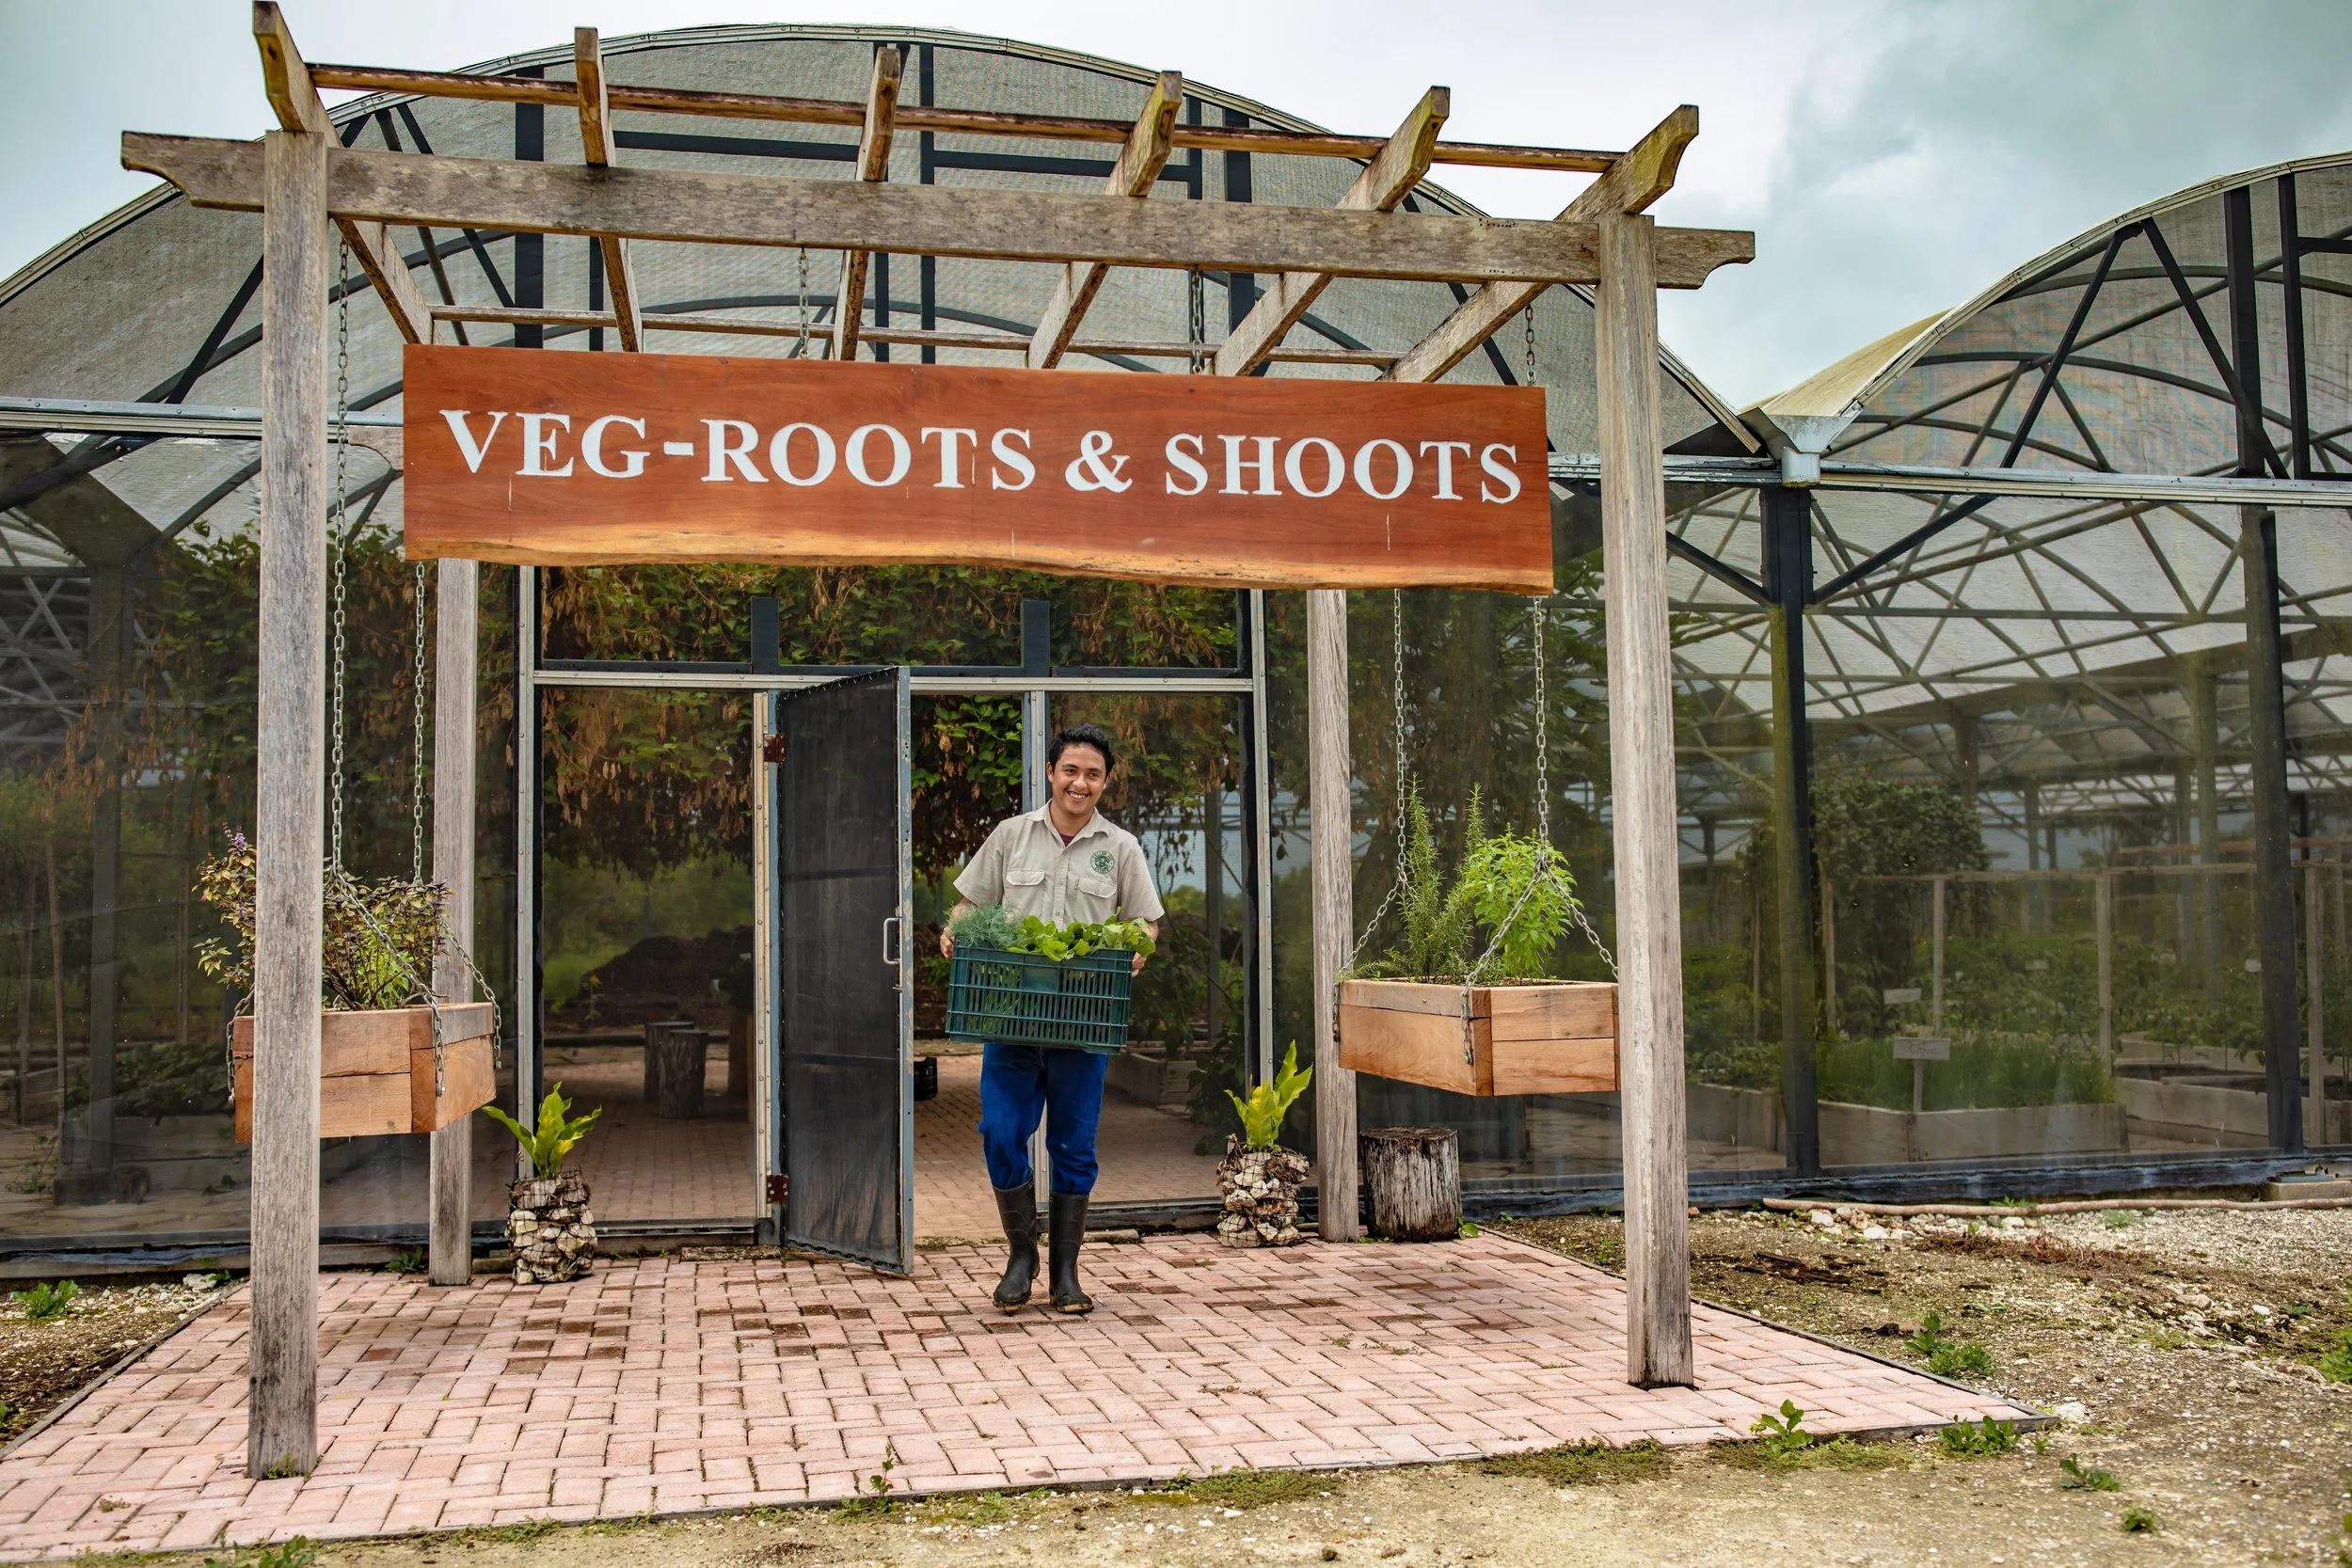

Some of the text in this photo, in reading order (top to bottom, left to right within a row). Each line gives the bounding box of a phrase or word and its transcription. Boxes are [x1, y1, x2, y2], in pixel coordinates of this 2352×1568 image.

[439, 409, 1521, 504] VEG-ROOTS & SHOOTS
